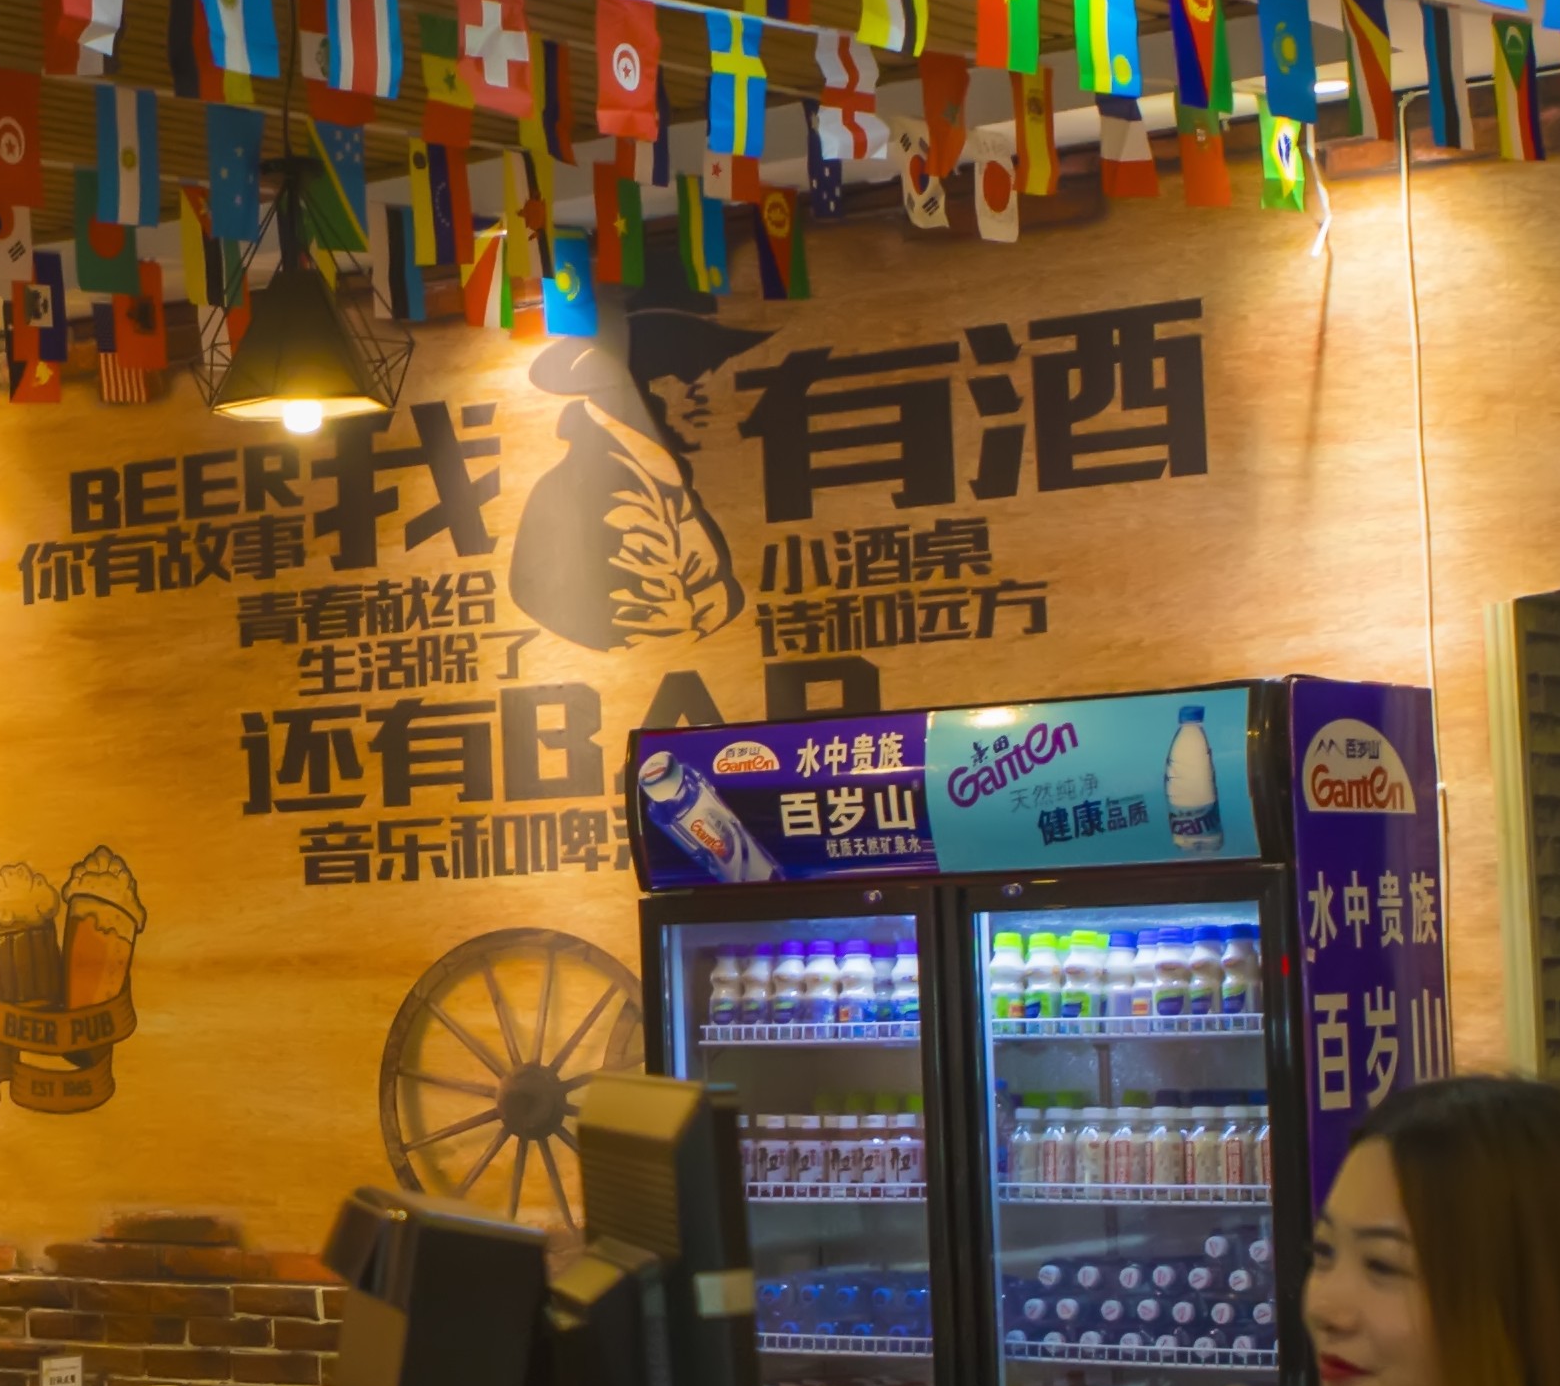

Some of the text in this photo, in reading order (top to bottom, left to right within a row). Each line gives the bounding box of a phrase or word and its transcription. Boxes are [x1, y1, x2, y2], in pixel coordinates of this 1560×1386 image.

[734, 297, 1209, 524] 有酒
[69, 443, 305, 534] BEER
[17, 514, 306, 606] 你有故事
[758, 516, 993, 596] 小酒桌
[236, 569, 497, 648] 青春献给
[755, 578, 1049, 658] 诗和远方
[298, 627, 542, 698] 生活除了
[796, 731, 905, 778] 水中贵族
[298, 810, 638, 886] 音乐和啤
[780, 784, 917, 838] 百岁山
[1037, 794, 1151, 846] 健康品质
[1307, 869, 1438, 950] 水中贵族
[1313, 985, 1449, 1111] 百岁山
